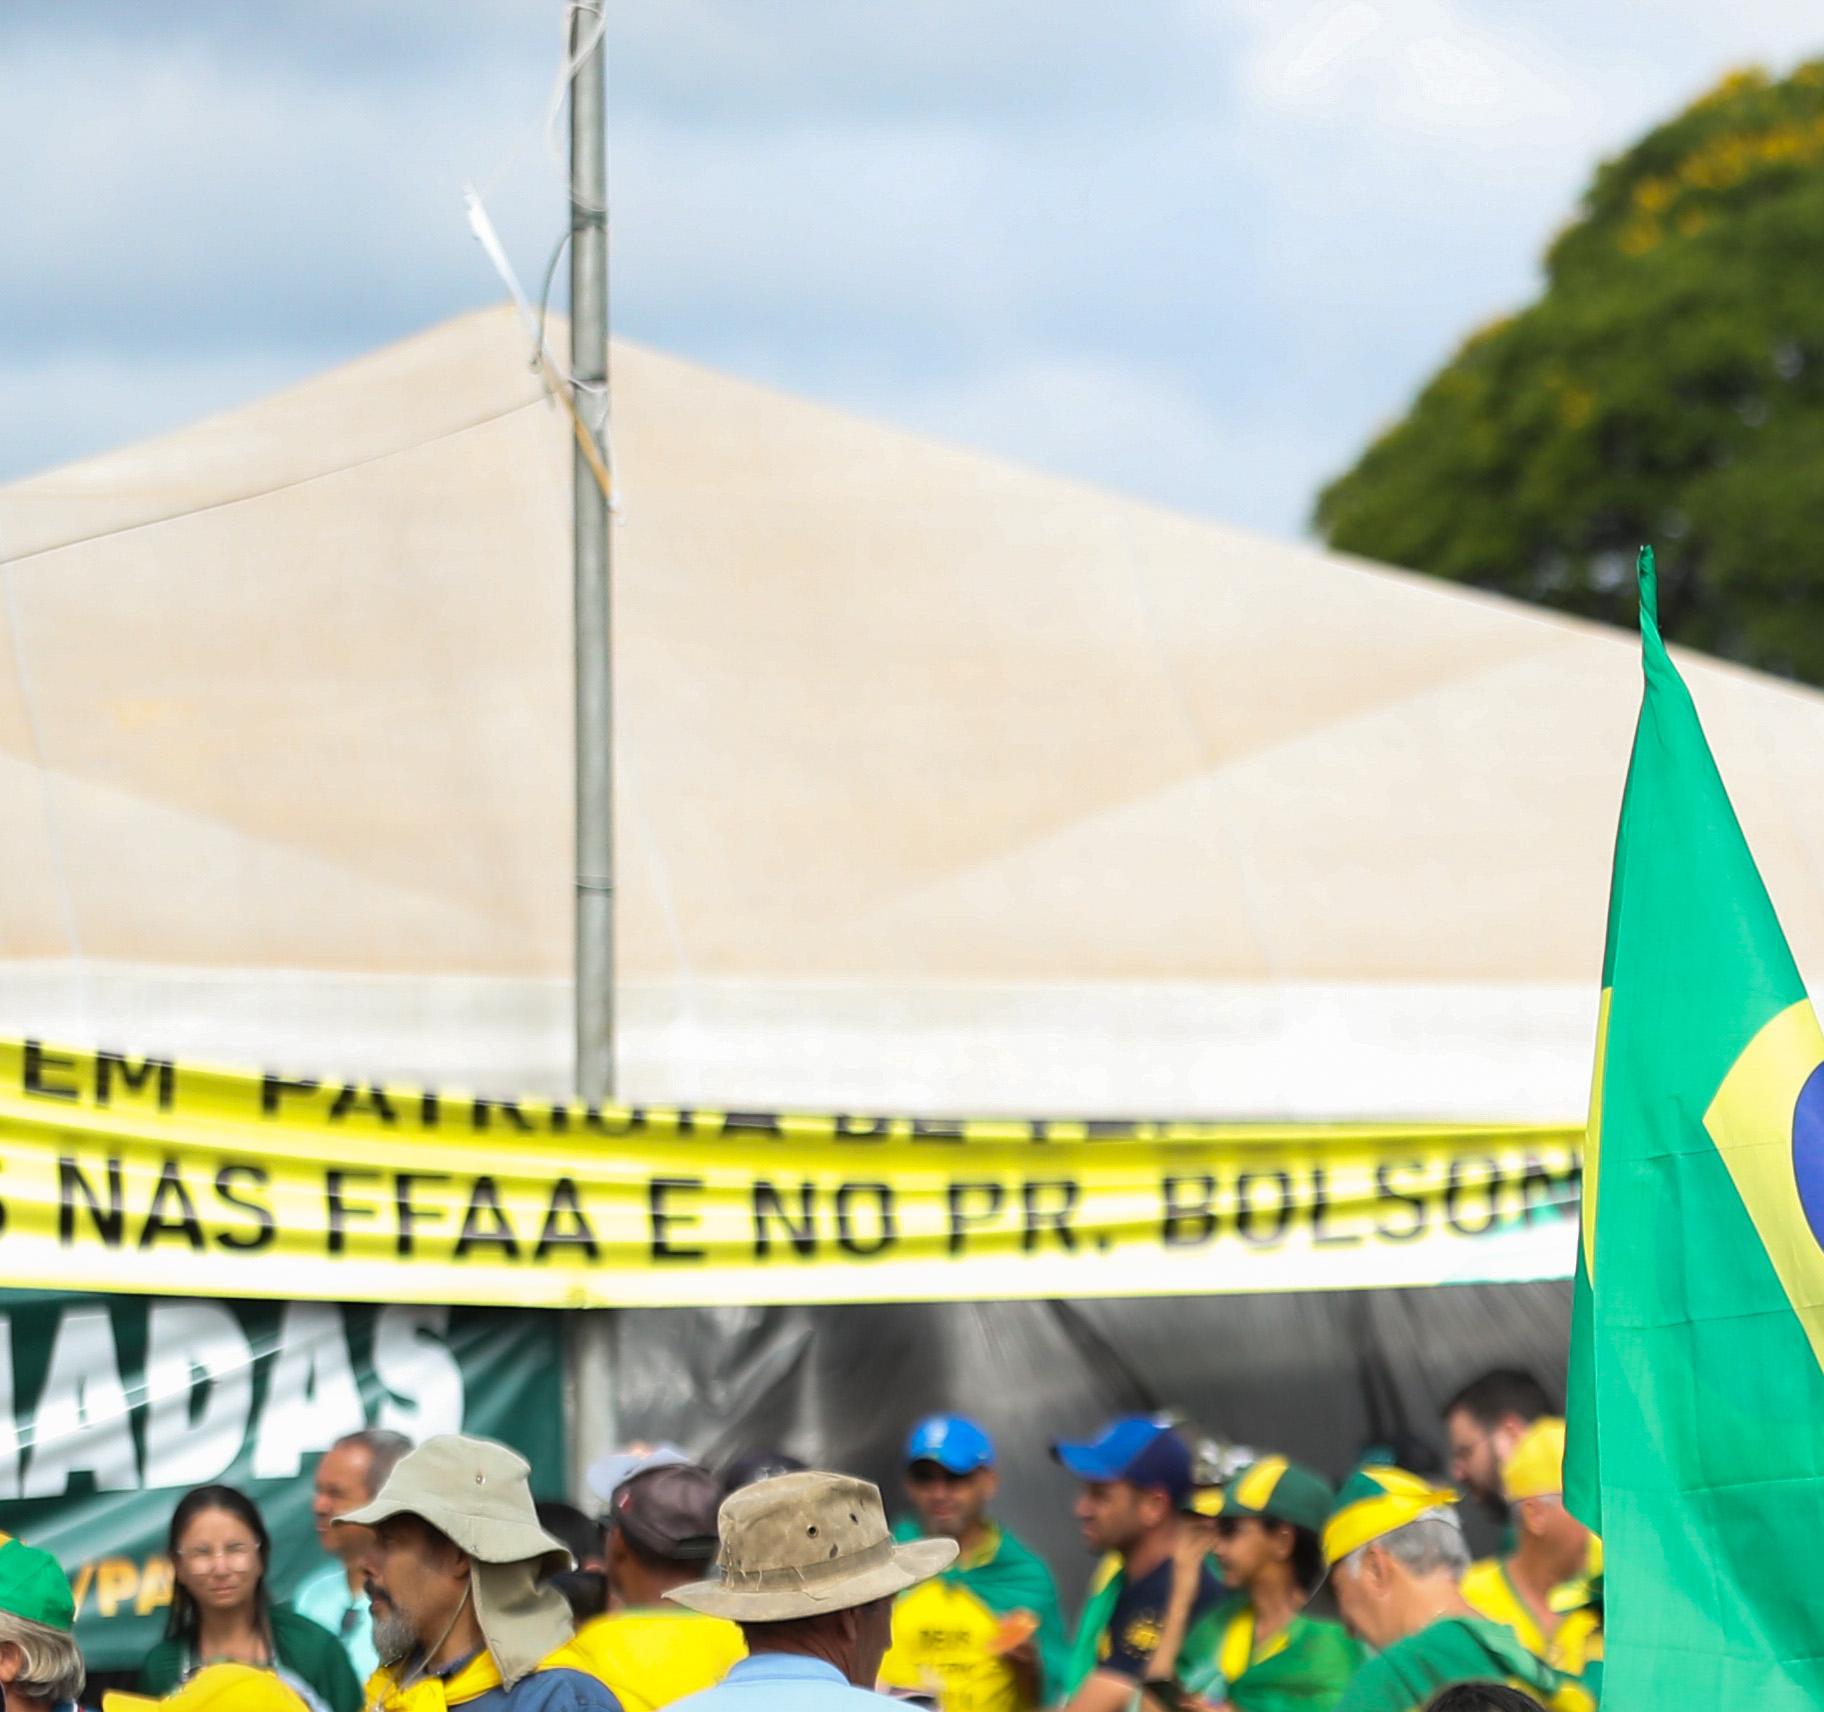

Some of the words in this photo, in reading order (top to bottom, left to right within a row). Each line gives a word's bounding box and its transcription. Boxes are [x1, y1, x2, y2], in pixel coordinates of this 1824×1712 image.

[58, 1155, 277, 1253] NAS
[325, 1168, 601, 1262] FFAA
[648, 1178, 708, 1261] E
[752, 1180, 898, 1258] NO
[948, 1180, 1111, 1255] PR.
